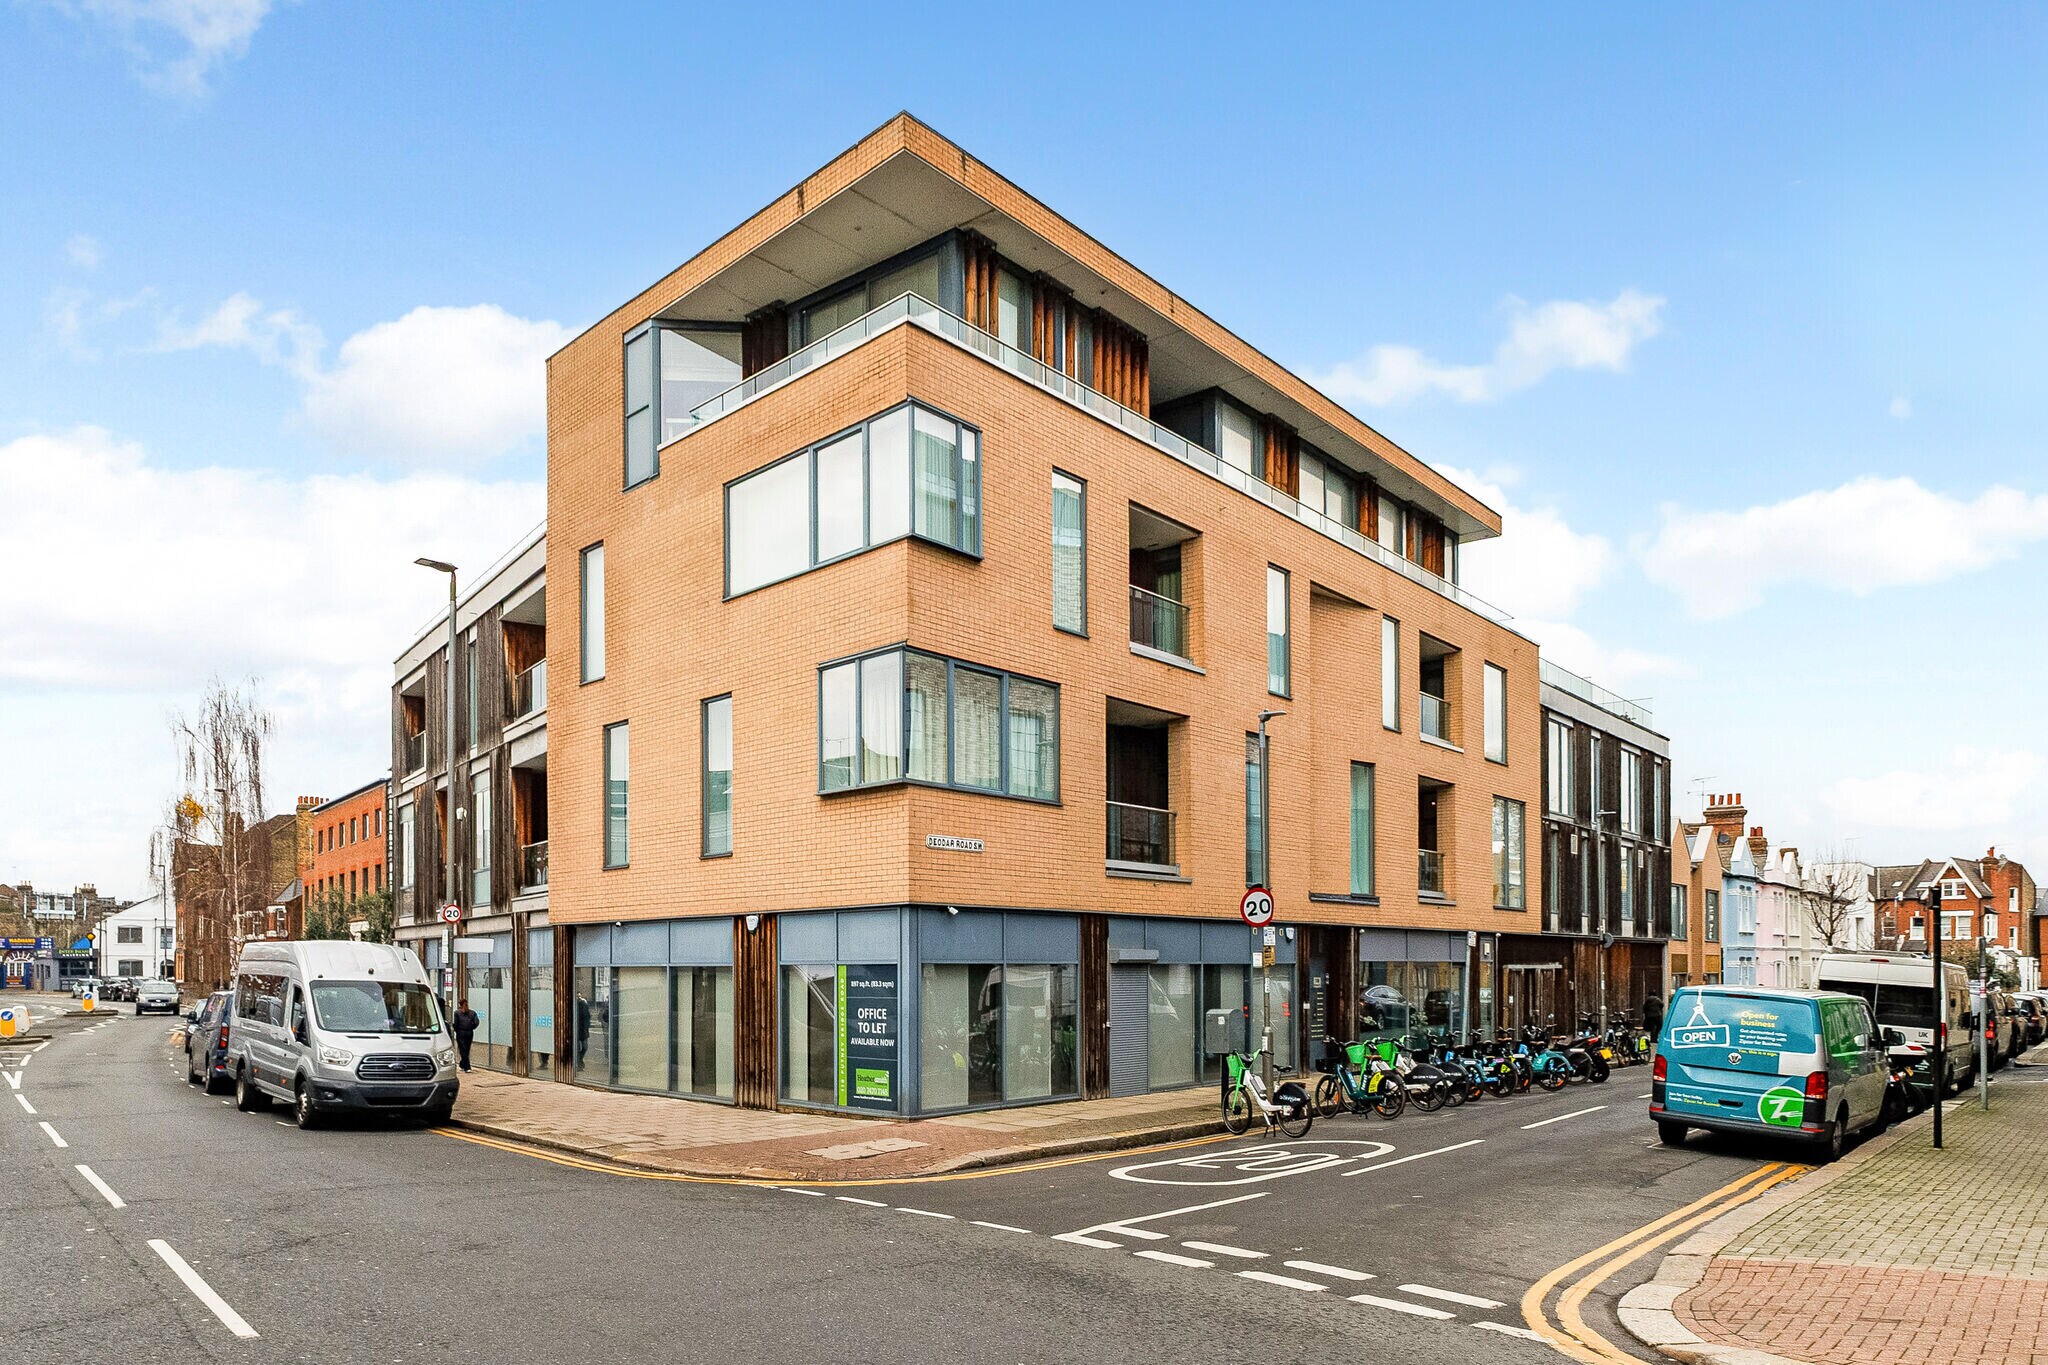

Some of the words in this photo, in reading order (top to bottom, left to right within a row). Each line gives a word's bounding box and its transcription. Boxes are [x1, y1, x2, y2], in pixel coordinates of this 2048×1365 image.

[928, 837, 955, 847] DEODAR
[956, 840, 973, 849] ROAD
[1246, 898, 1271, 917] 20
[446, 910, 459, 918] 20
[857, 1008, 887, 1019] OFFICE
[1741, 1010, 1764, 1020] Open
[1766, 1012, 1779, 1020] for
[858, 1022, 870, 1033] TO
[871, 1023, 887, 1034] LET
[1740, 1019, 1775, 1028] business
[851, 1037, 879, 1046] AVAILABLE
[880, 1039, 895, 1047] NOW
[1682, 1031, 1716, 1042] OPEN
[1178, 1150, 1340, 1171] 20
